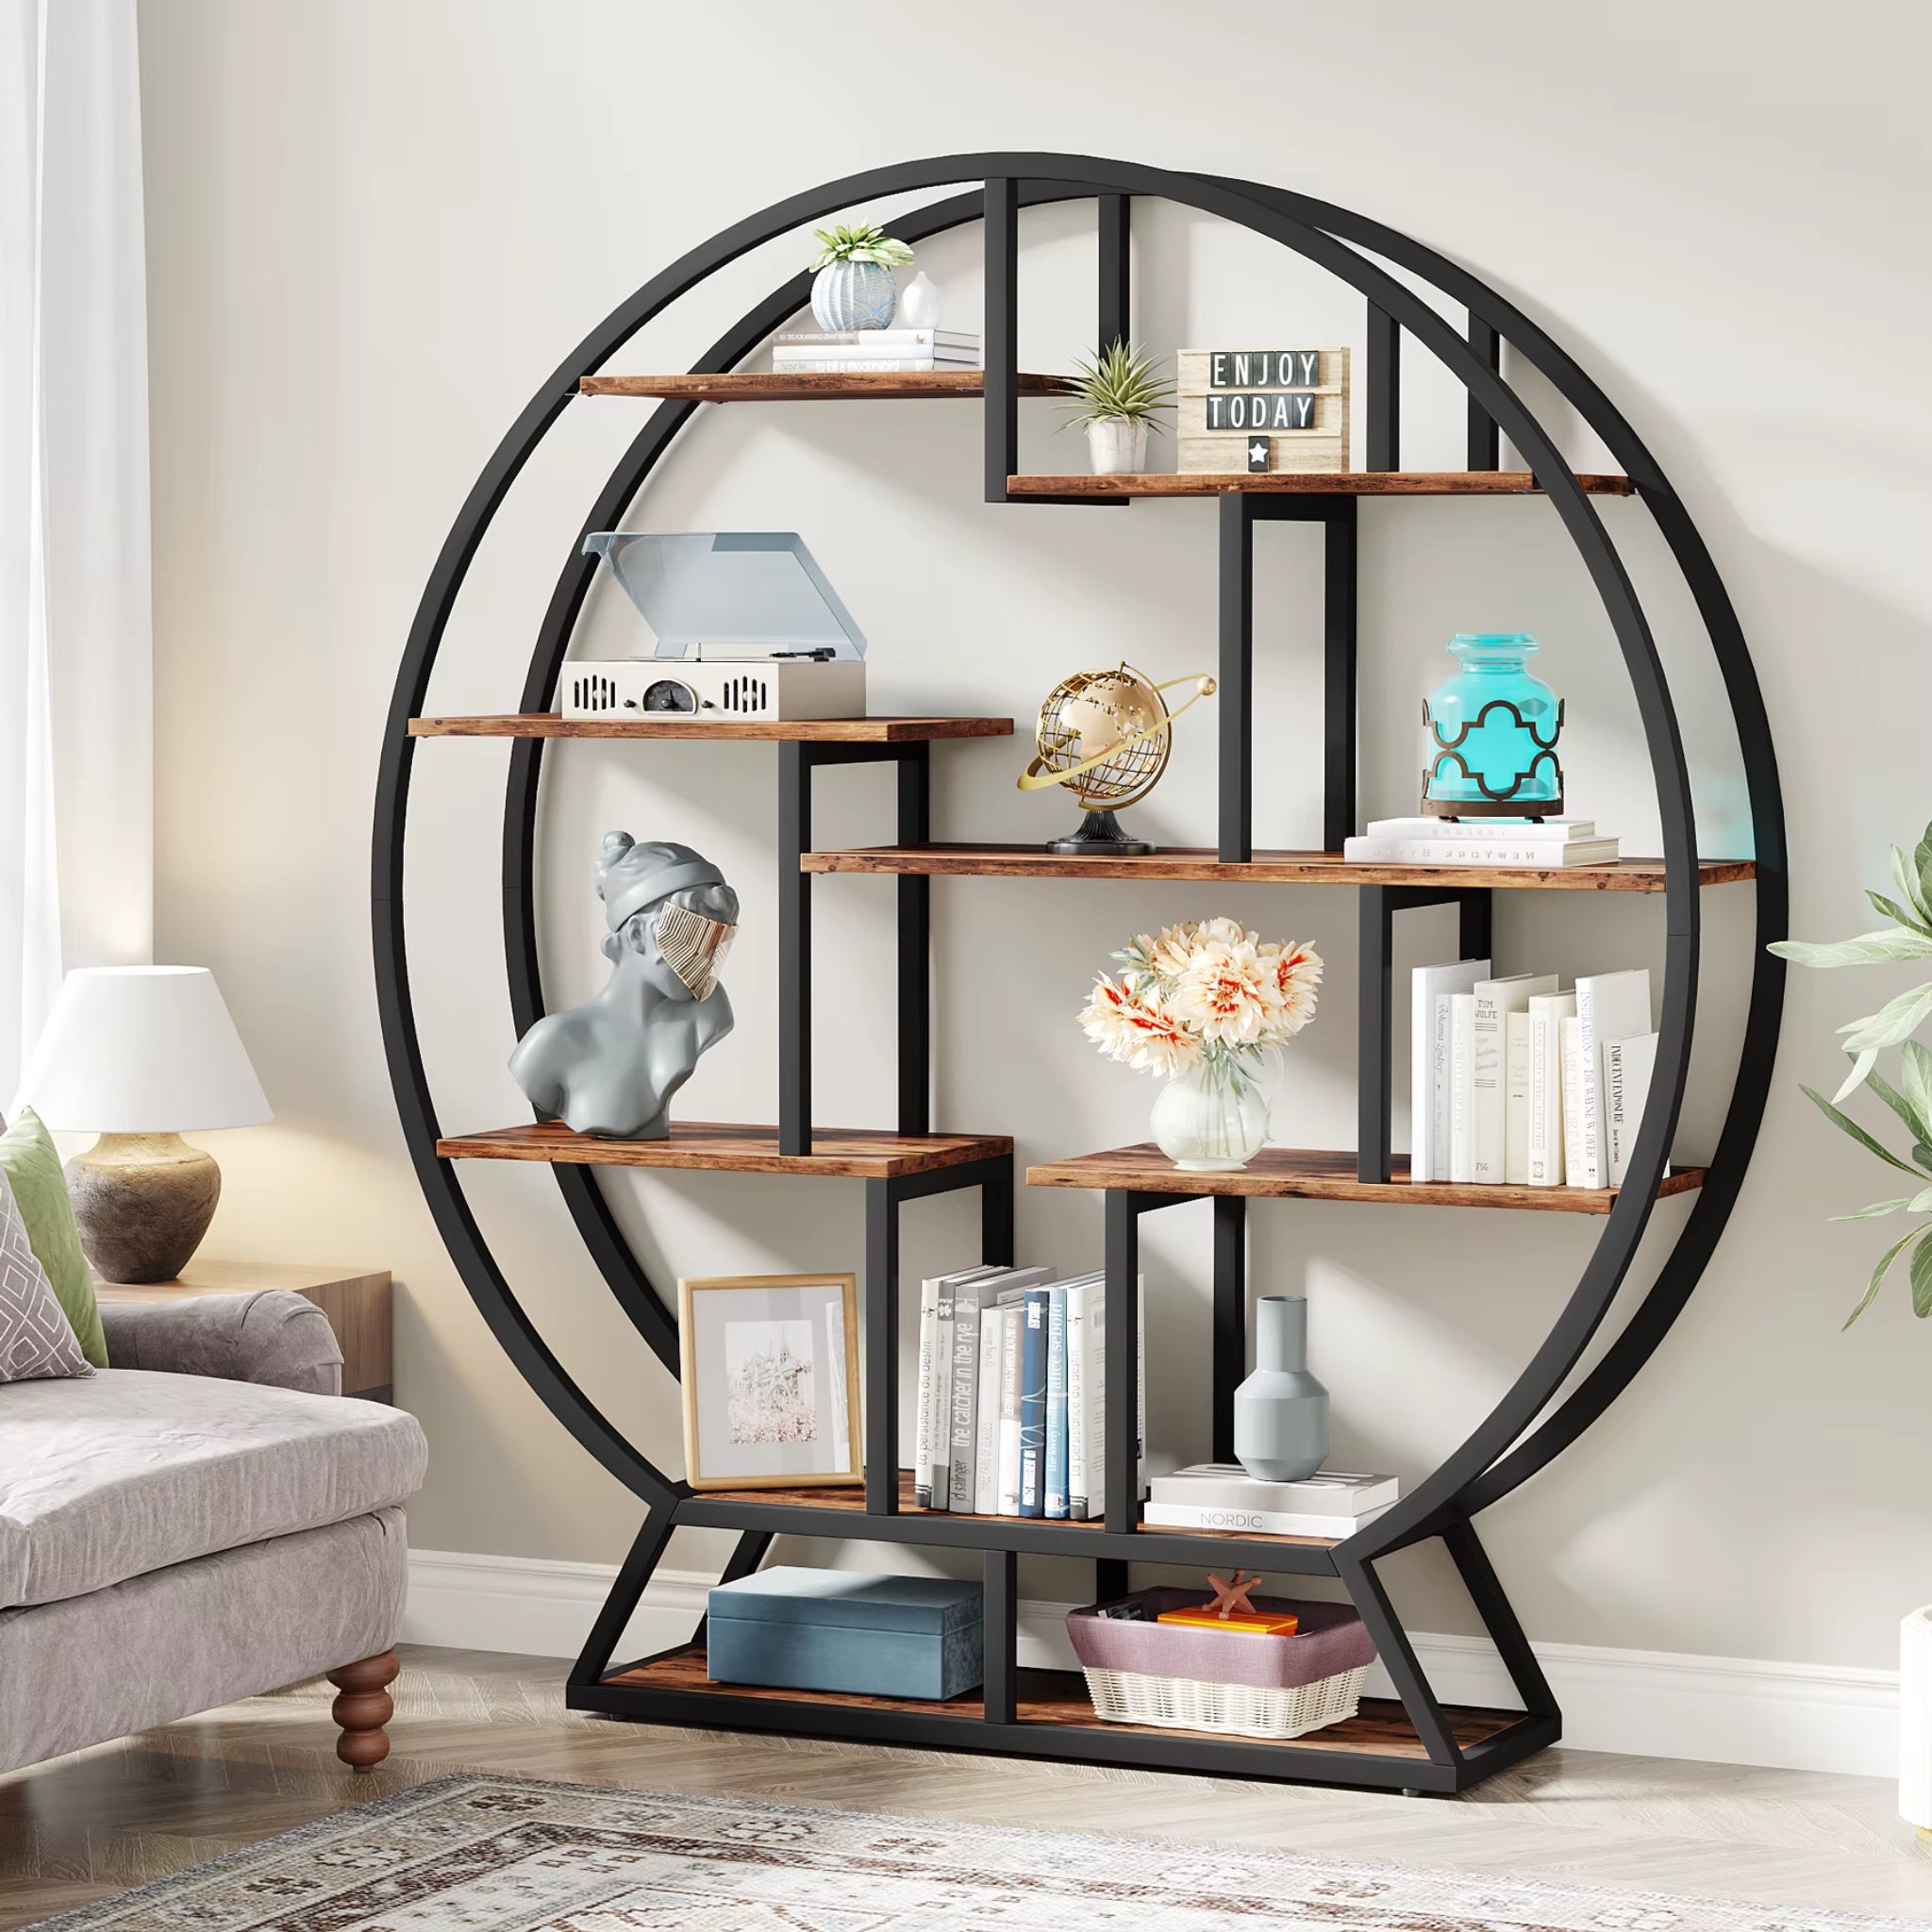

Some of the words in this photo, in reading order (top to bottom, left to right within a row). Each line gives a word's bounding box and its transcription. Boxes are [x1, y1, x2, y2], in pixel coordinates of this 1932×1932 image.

[1213, 353, 1315, 386] ENJOY
[1209, 395, 1311, 428] TODAY
[1474, 1010, 1498, 1020] WOLFE
[1477, 999, 1493, 1008] TOM
[1580, 991, 1591, 1053] INSPIRATION
[1585, 1086, 1595, 1120] WAYNE
[1566, 1109, 1579, 1171] DREAMS
[1586, 1133, 1596, 1158] DYER
[956, 1323, 978, 1342] rye
[1050, 1303, 1063, 1351] sebold
[921, 1341, 932, 1373] destin
[953, 1346, 973, 1364] the
[1071, 1350, 1080, 1381] destin
[922, 1374, 930, 1389] du
[954, 1369, 973, 1378] in
[1050, 1355, 1062, 1389] alice
[952, 1381, 972, 1425] catcher
[1071, 1385, 1080, 1398] du
[918, 1391, 932, 1451] persistance
[1071, 1402, 1086, 1461] persistance
[951, 1429, 971, 1446] the
[1047, 1430, 1060, 1455] lovely
[918, 1455, 927, 1466] La
[1046, 1456, 1058, 1472] the
[1071, 1465, 1081, 1476] La
[951, 1459, 971, 1491] salinger
[951, 1492, 969, 1503] jd
[1200, 1512, 1264, 1528] NORDIC
